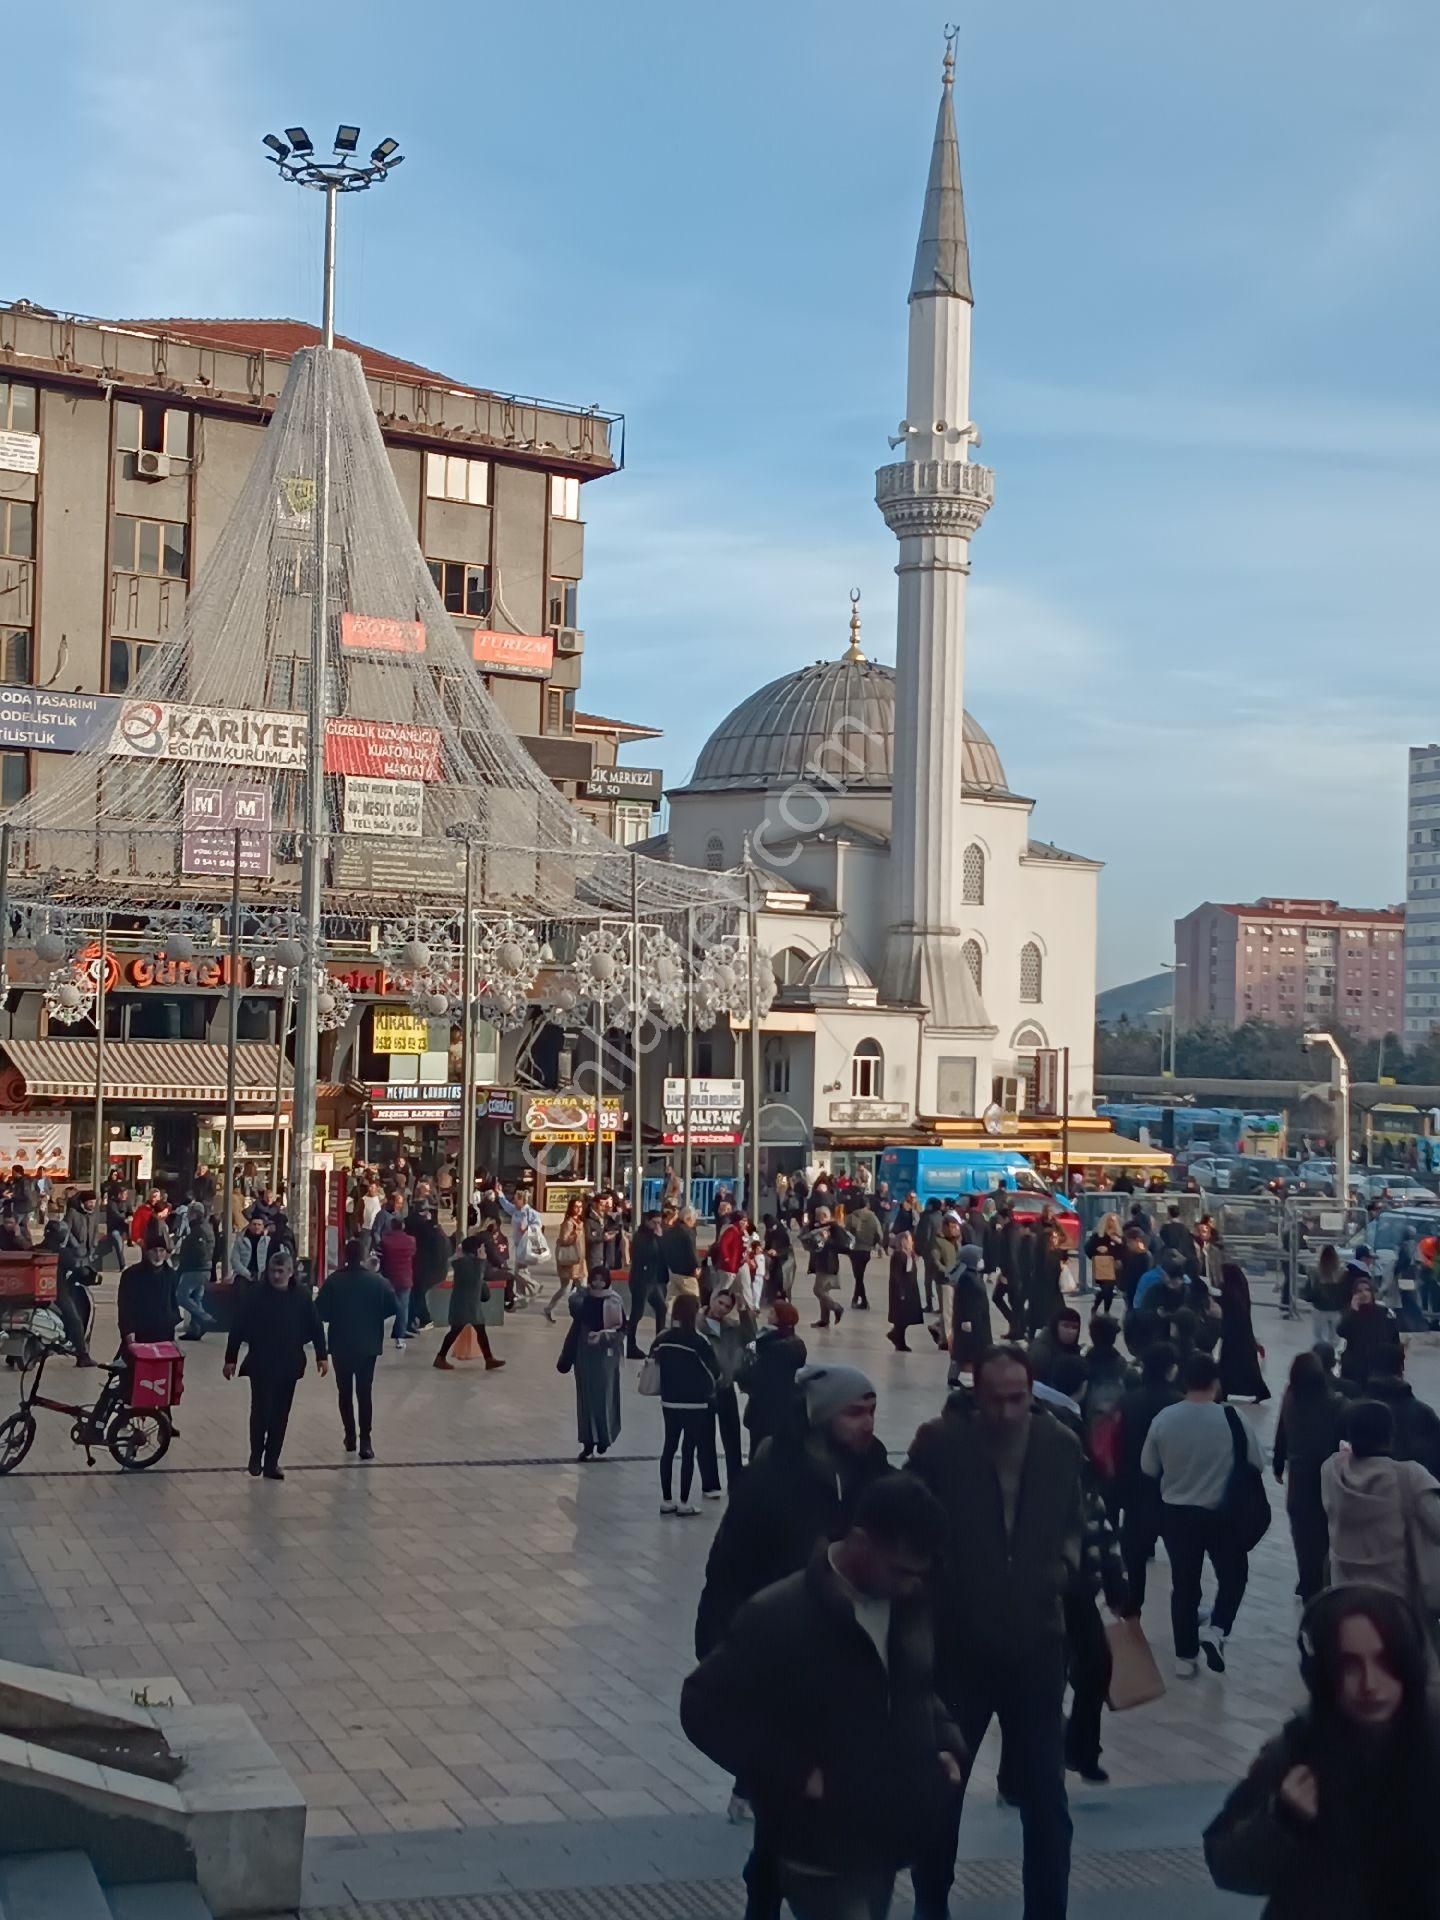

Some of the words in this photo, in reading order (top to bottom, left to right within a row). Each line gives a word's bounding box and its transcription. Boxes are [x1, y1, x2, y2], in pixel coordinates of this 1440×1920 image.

[0, 691, 32, 704] ODA
[36, 695, 97, 711] TASARIMI
[0, 709, 77, 727] ODELİSTLİK
[609, 771, 653, 786] MERKEZİ
